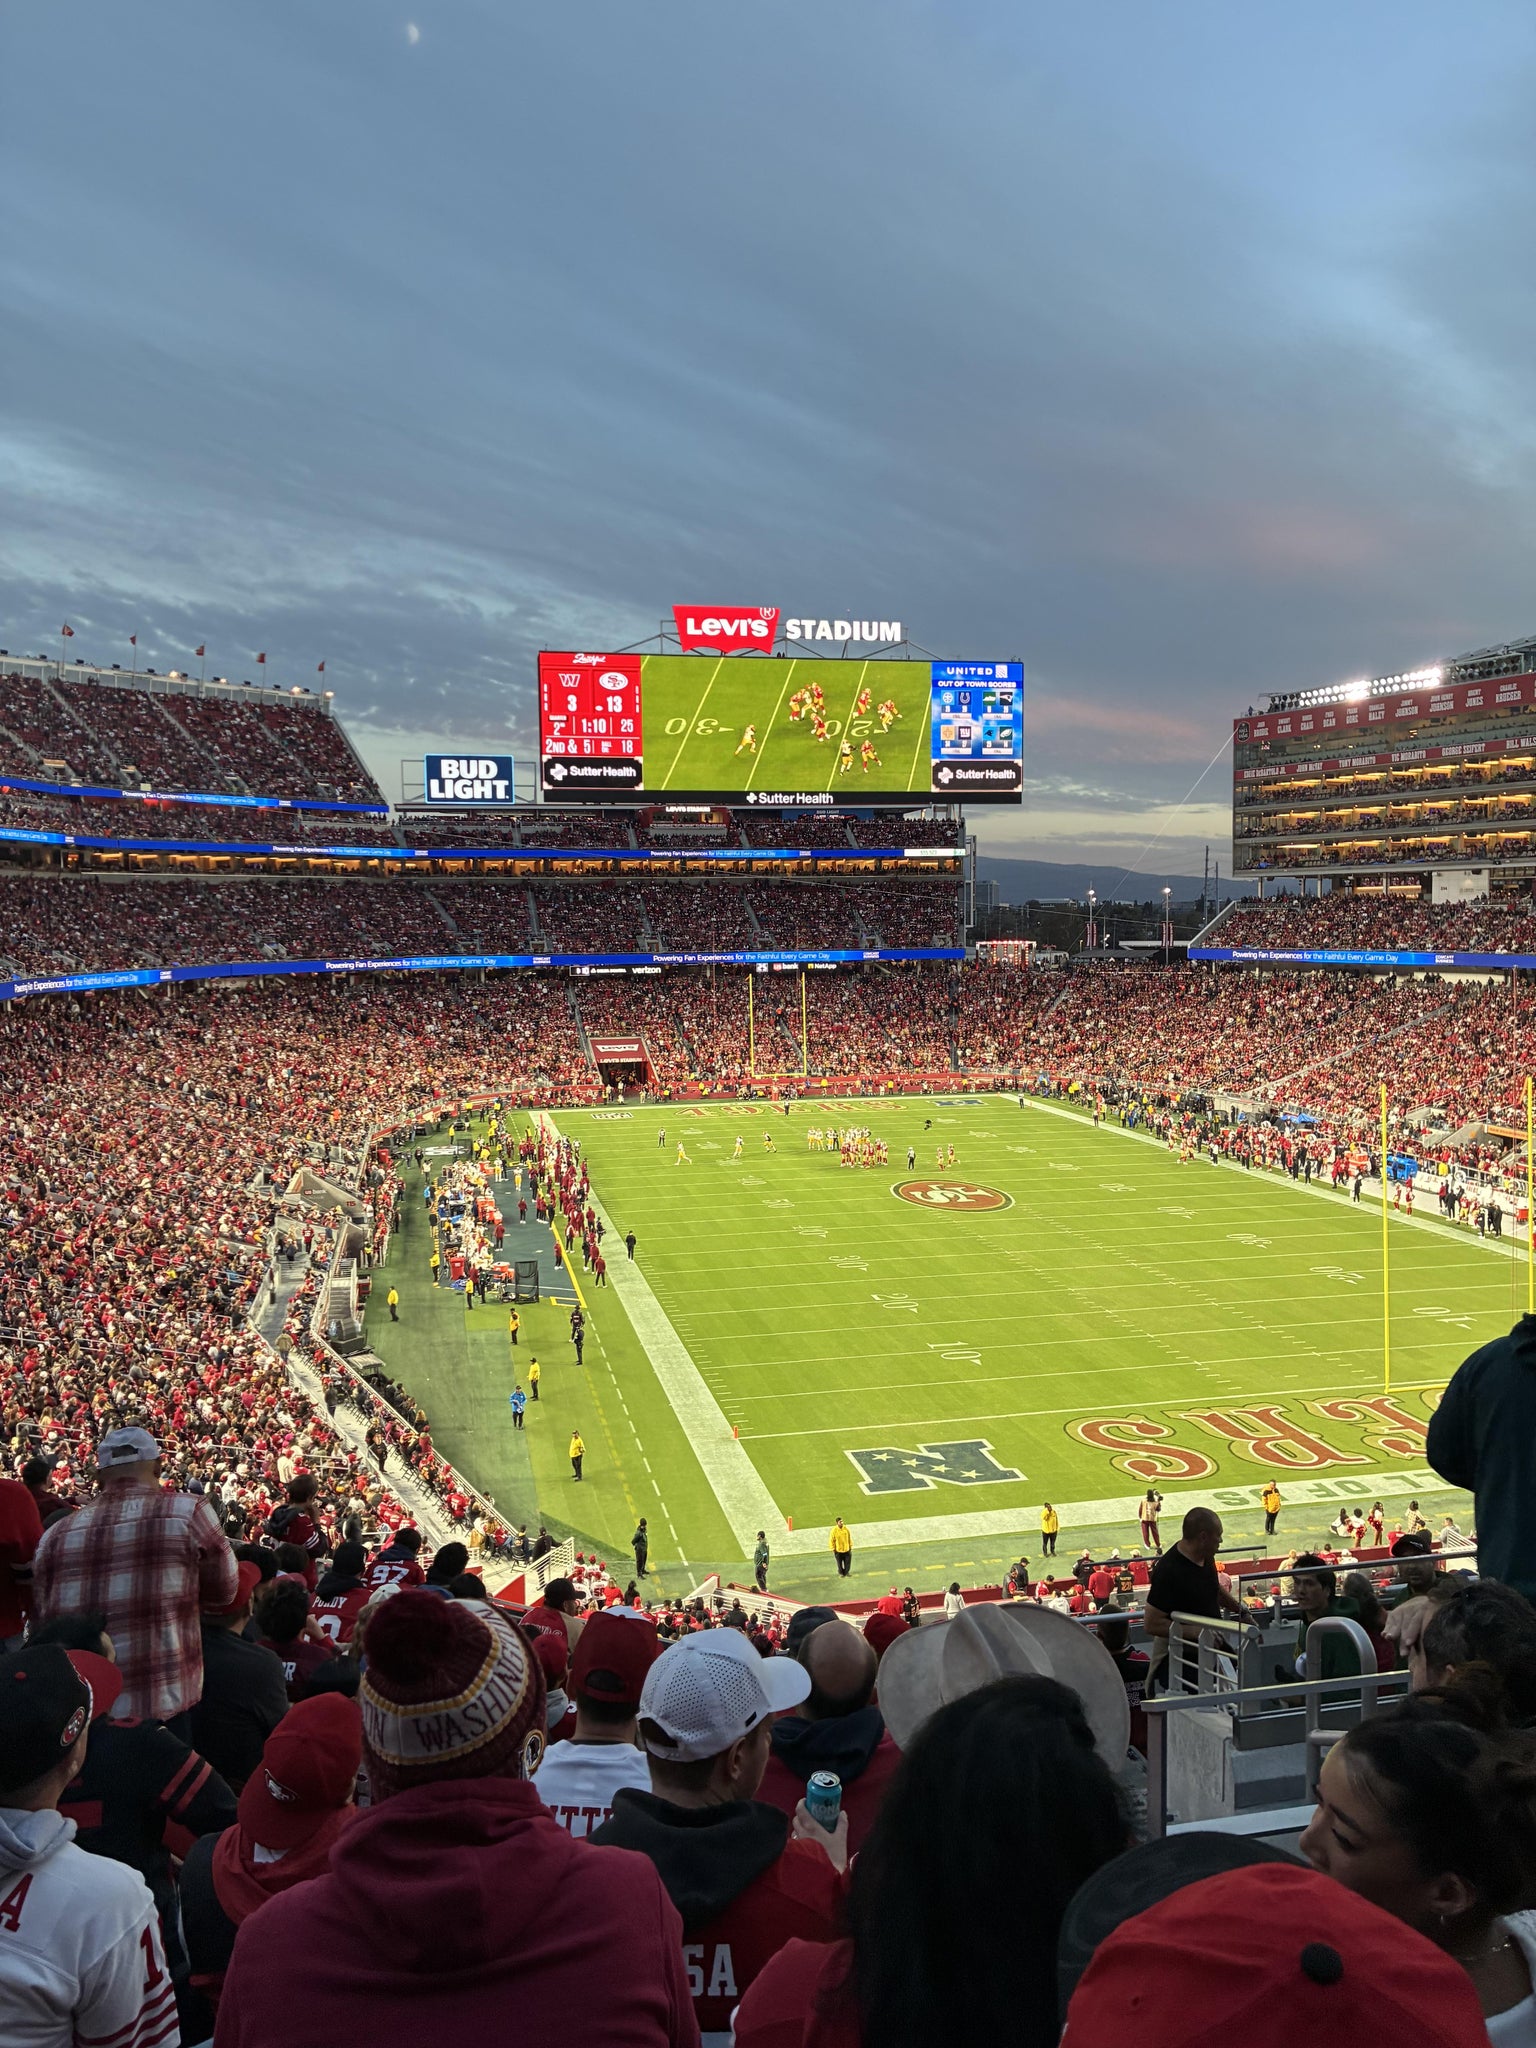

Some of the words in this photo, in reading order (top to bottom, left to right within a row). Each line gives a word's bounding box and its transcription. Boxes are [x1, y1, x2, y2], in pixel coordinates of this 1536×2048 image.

[786, 619, 900, 641] STADIUM
[947, 667, 992, 676] UNITED
[567, 695, 577, 712] 3
[606, 696, 622, 712] 13
[582, 718, 606, 733] 1:10
[620, 719, 634, 732] 25
[545, 740, 565, 753] 2ND
[567, 740, 578, 753] &
[584, 740, 591, 753] 5
[622, 740, 633, 753] 18
[1520, 737, 1536, 747] WALS
[440, 759, 498, 779] BUD
[570, 766, 602, 776] Sutter
[603, 766, 636, 777] Health
[956, 770, 984, 780] Sutter
[986, 770, 1016, 780] Health
[430, 779, 507, 799] LIGHT
[758, 792, 796, 804] Sutter
[796, 792, 834, 804] Health
[781, 952, 797, 961] Every
[819, 952, 830, 960] Day
[1233, 951, 1257, 959] Powering
[1270, 951, 1302, 960] Experiences
[1348, 954, 1363, 962] Every
[1386, 954, 1398, 962] Day
[368, 960, 402, 968] Experiences
[34, 980, 65, 991] Experiences
[828, 1255, 869, 1268] 30
[1309, 1266, 1366, 1280] 20
[871, 1292, 919, 1310] 20
[1412, 1306, 1478, 1324] 10
[927, 1340, 982, 1361] 10
[1307, 1479, 1373, 1498] OF
[371, 1565, 409, 1584] 97
